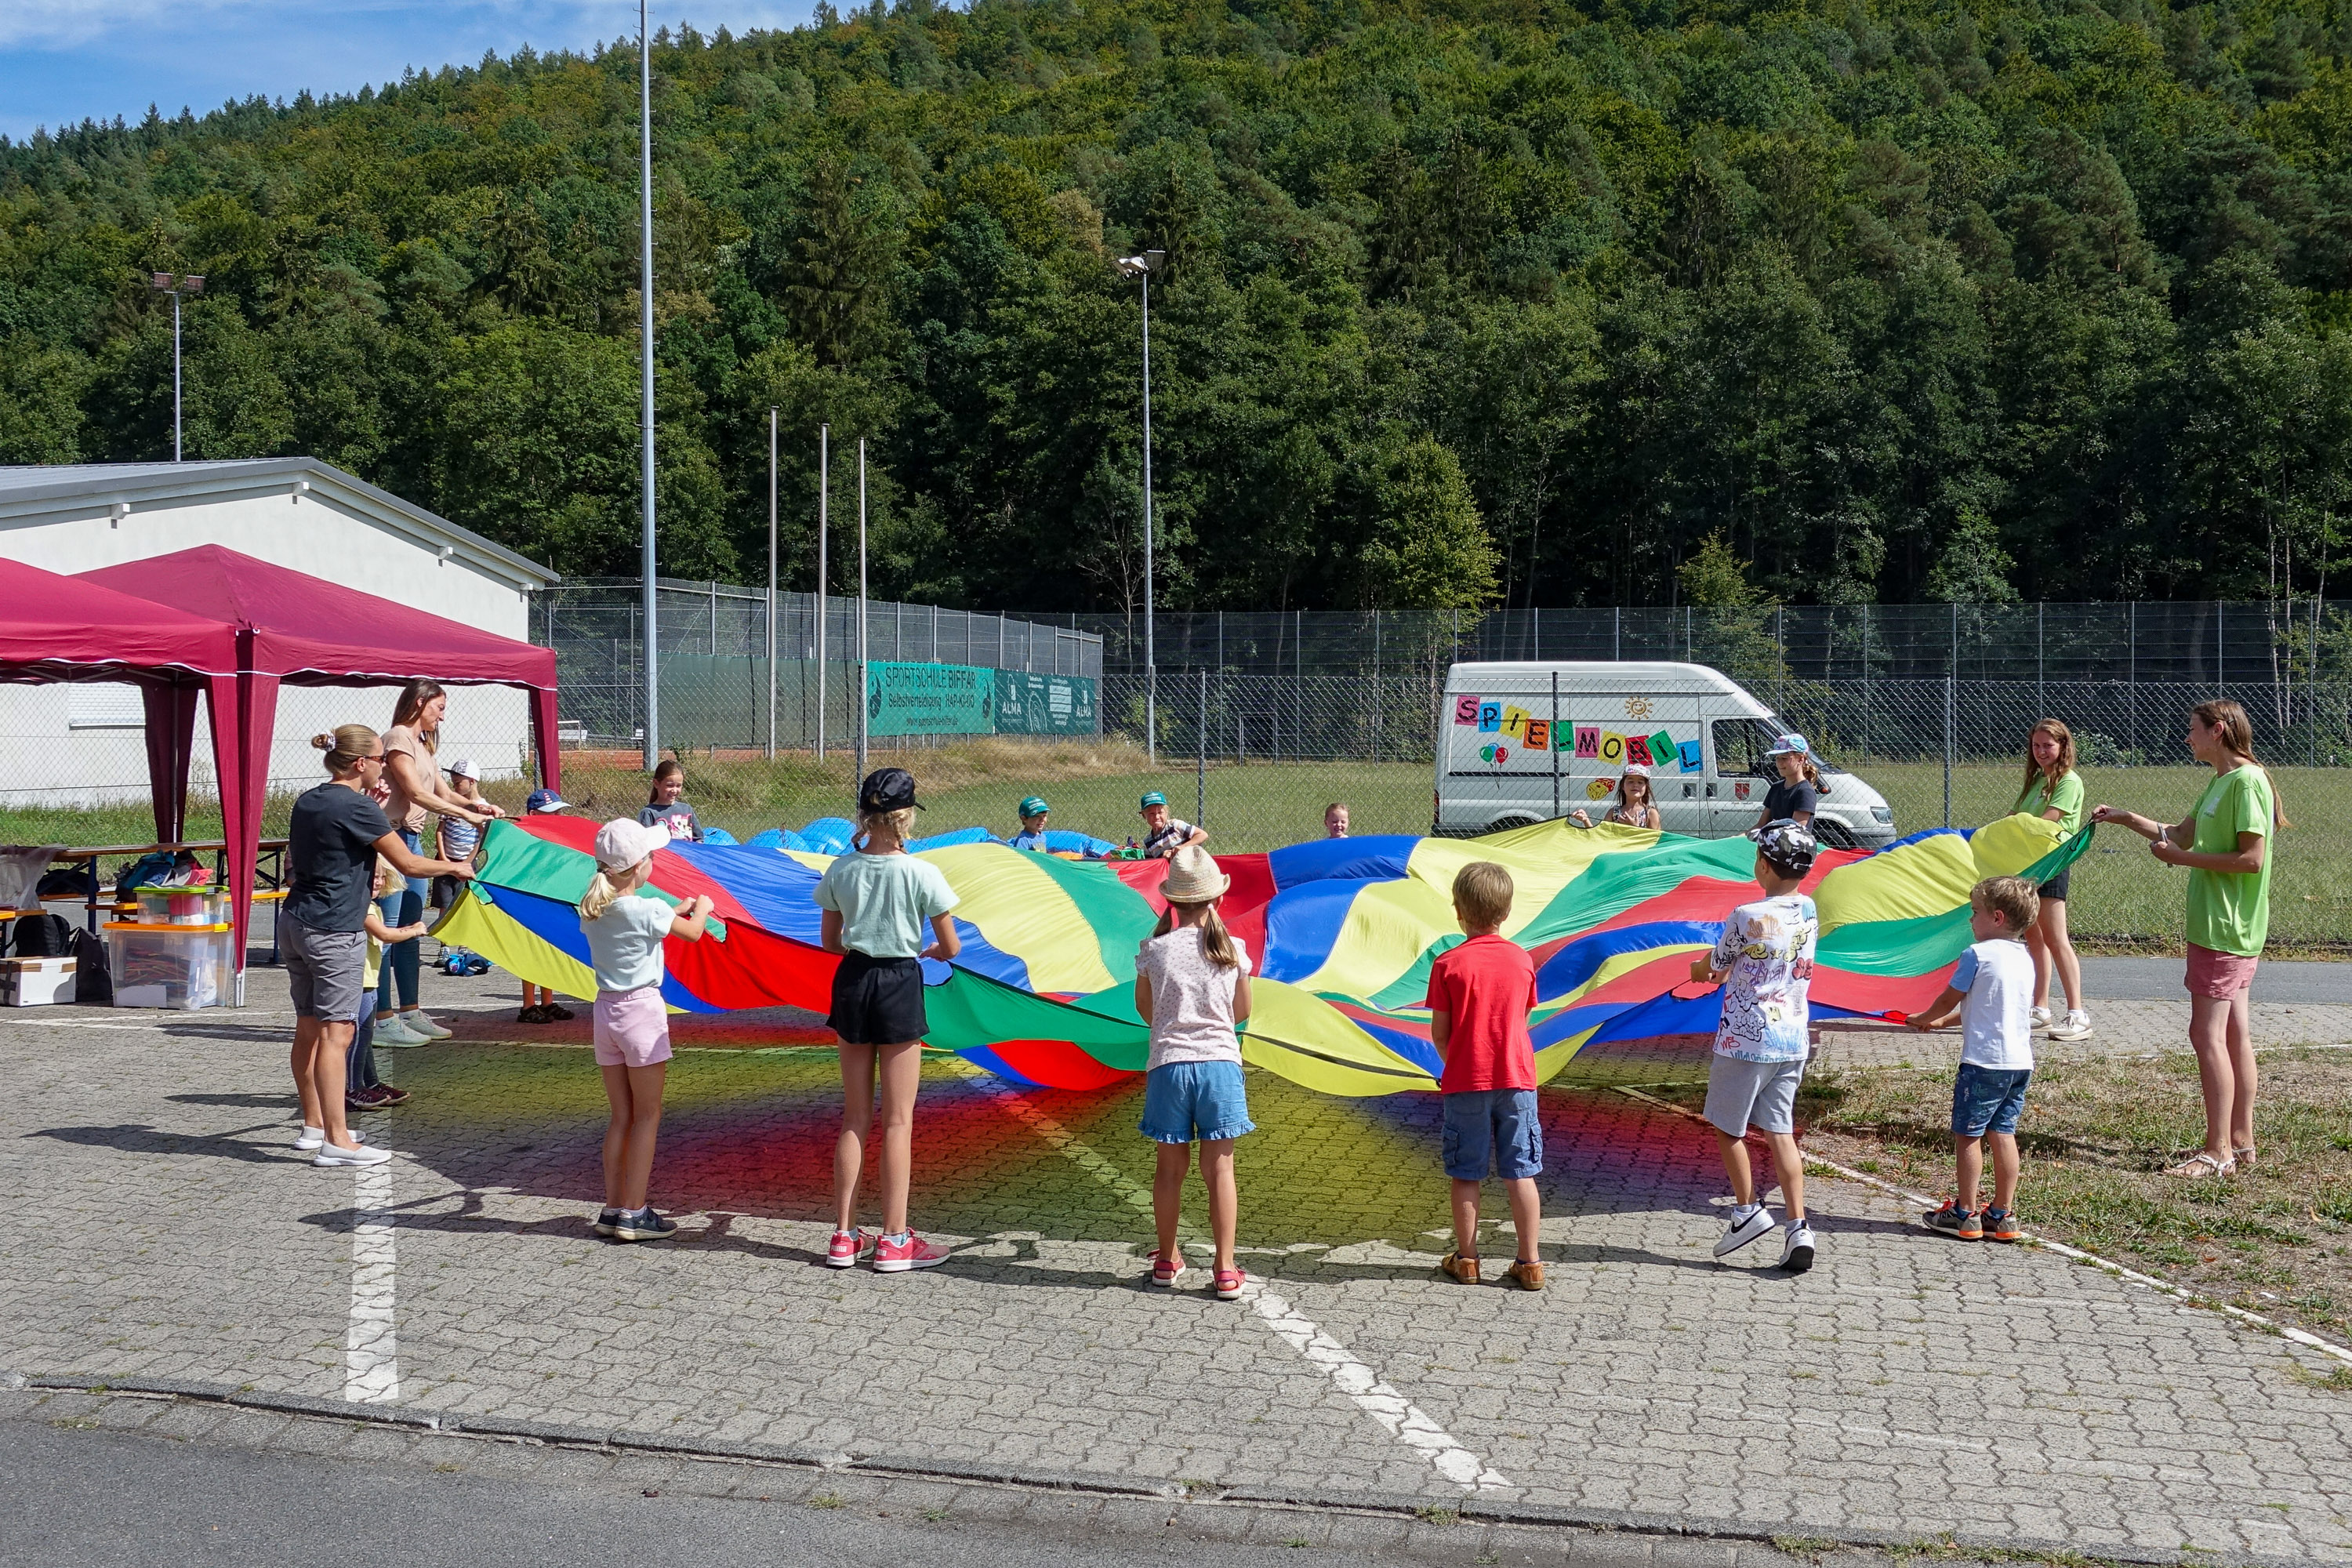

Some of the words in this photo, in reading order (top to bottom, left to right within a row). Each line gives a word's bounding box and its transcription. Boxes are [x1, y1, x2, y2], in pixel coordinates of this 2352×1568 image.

[885, 666, 946, 688] SPORTSCHULE
[948, 670, 977, 690] BIFFAR
[888, 693, 942, 711] Selbstverteidigung
[1002, 701, 1022, 715] ALMA
[1076, 704, 1092, 717] ALMA
